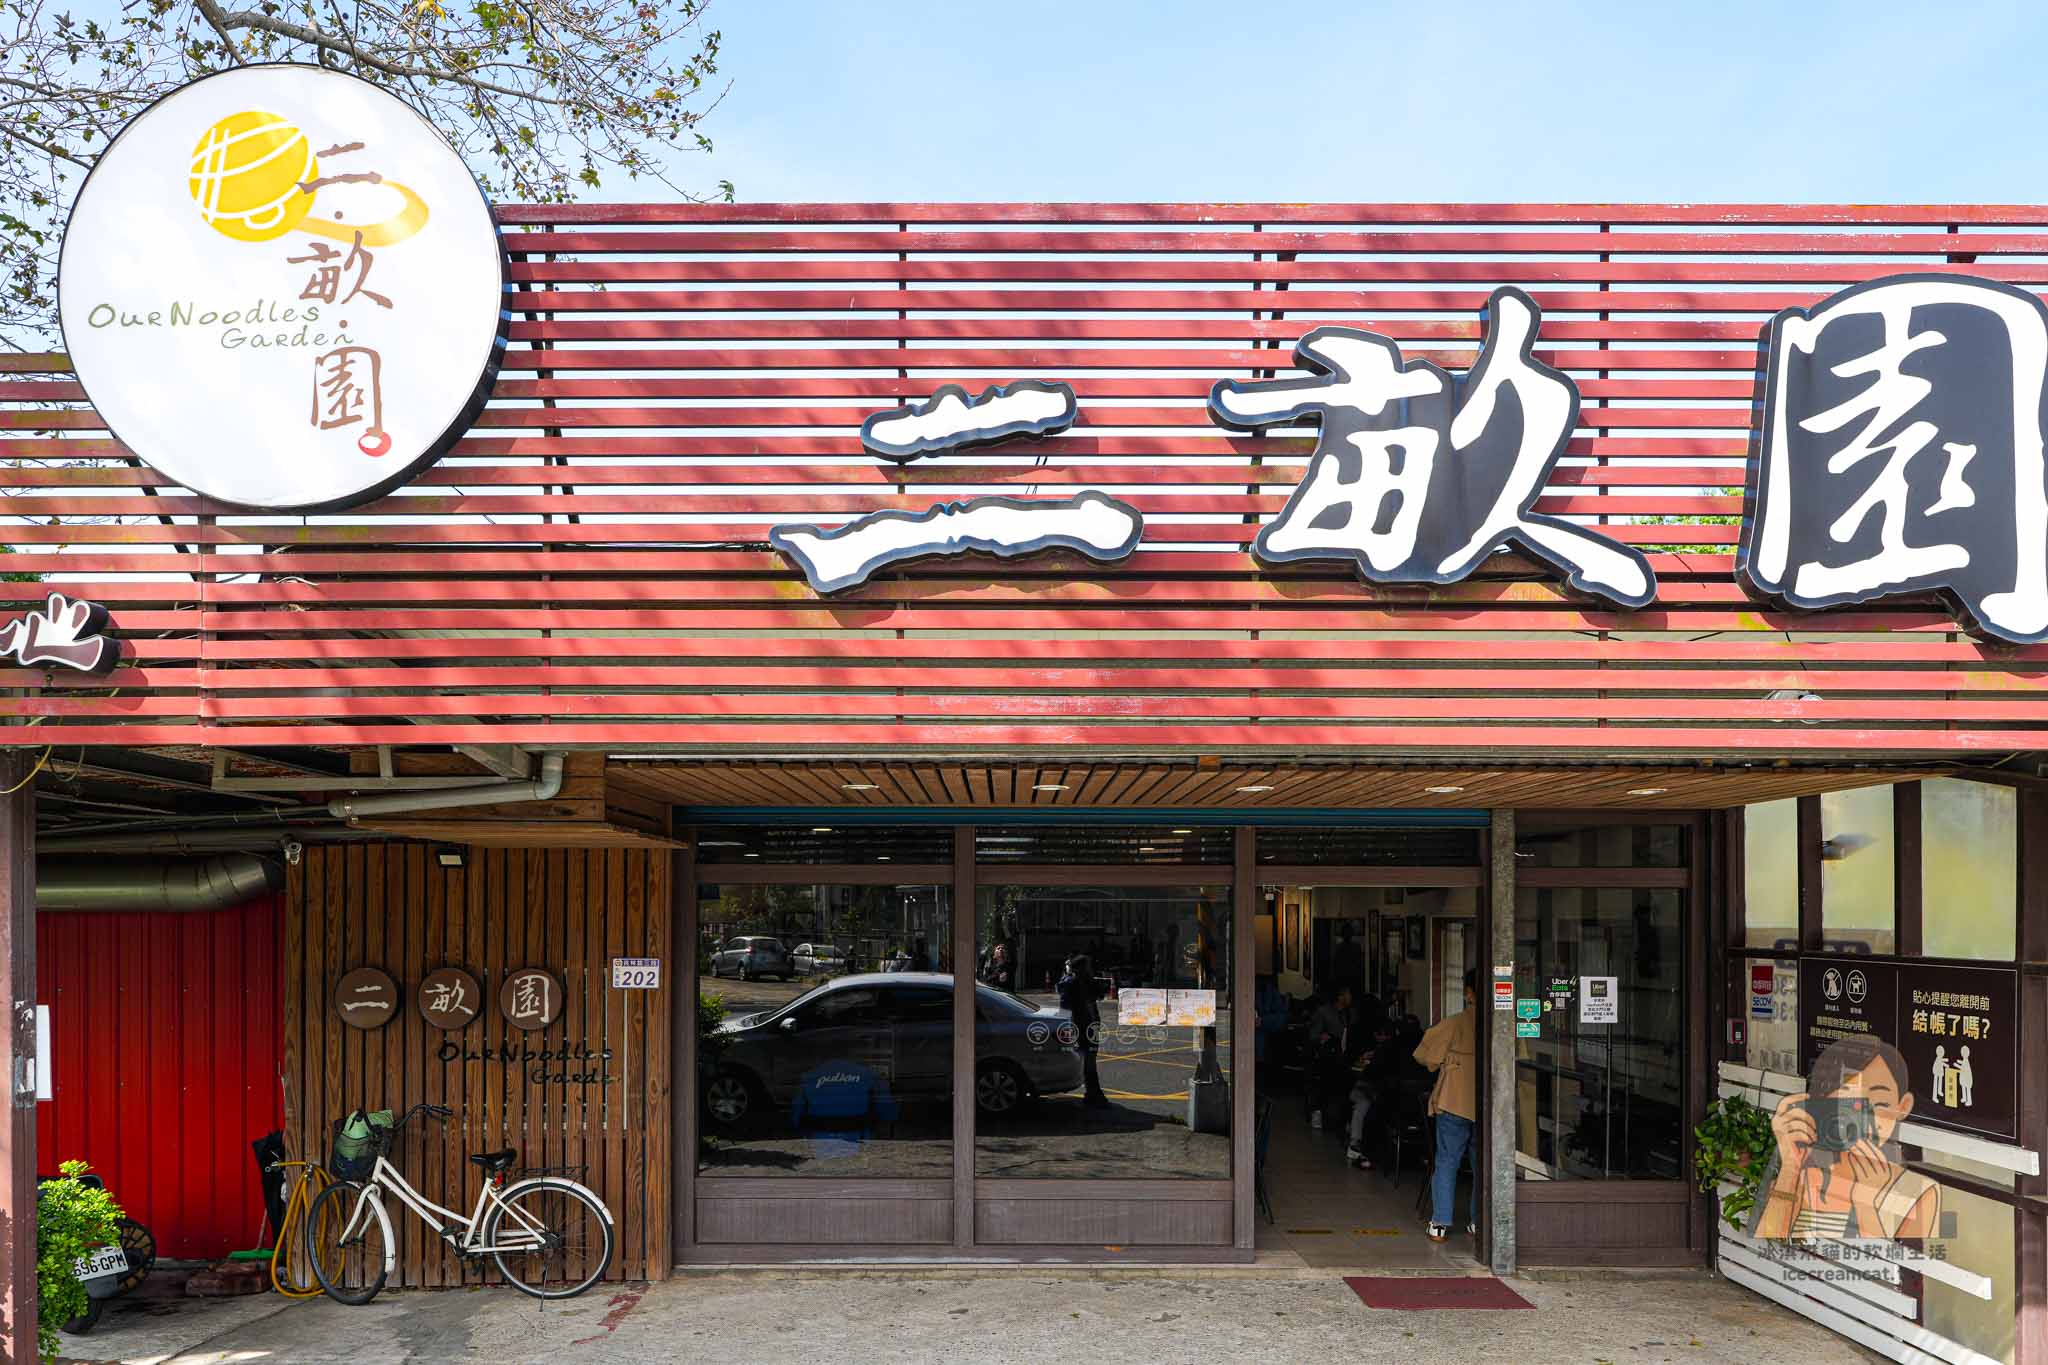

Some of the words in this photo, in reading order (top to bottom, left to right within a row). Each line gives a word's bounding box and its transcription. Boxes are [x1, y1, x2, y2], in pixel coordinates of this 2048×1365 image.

[622, 970, 656, 986] 202
[1912, 989, 1990, 1012] 貼心提醒您離開前
[1912, 1008, 1991, 1040] 結帳了嗎?
